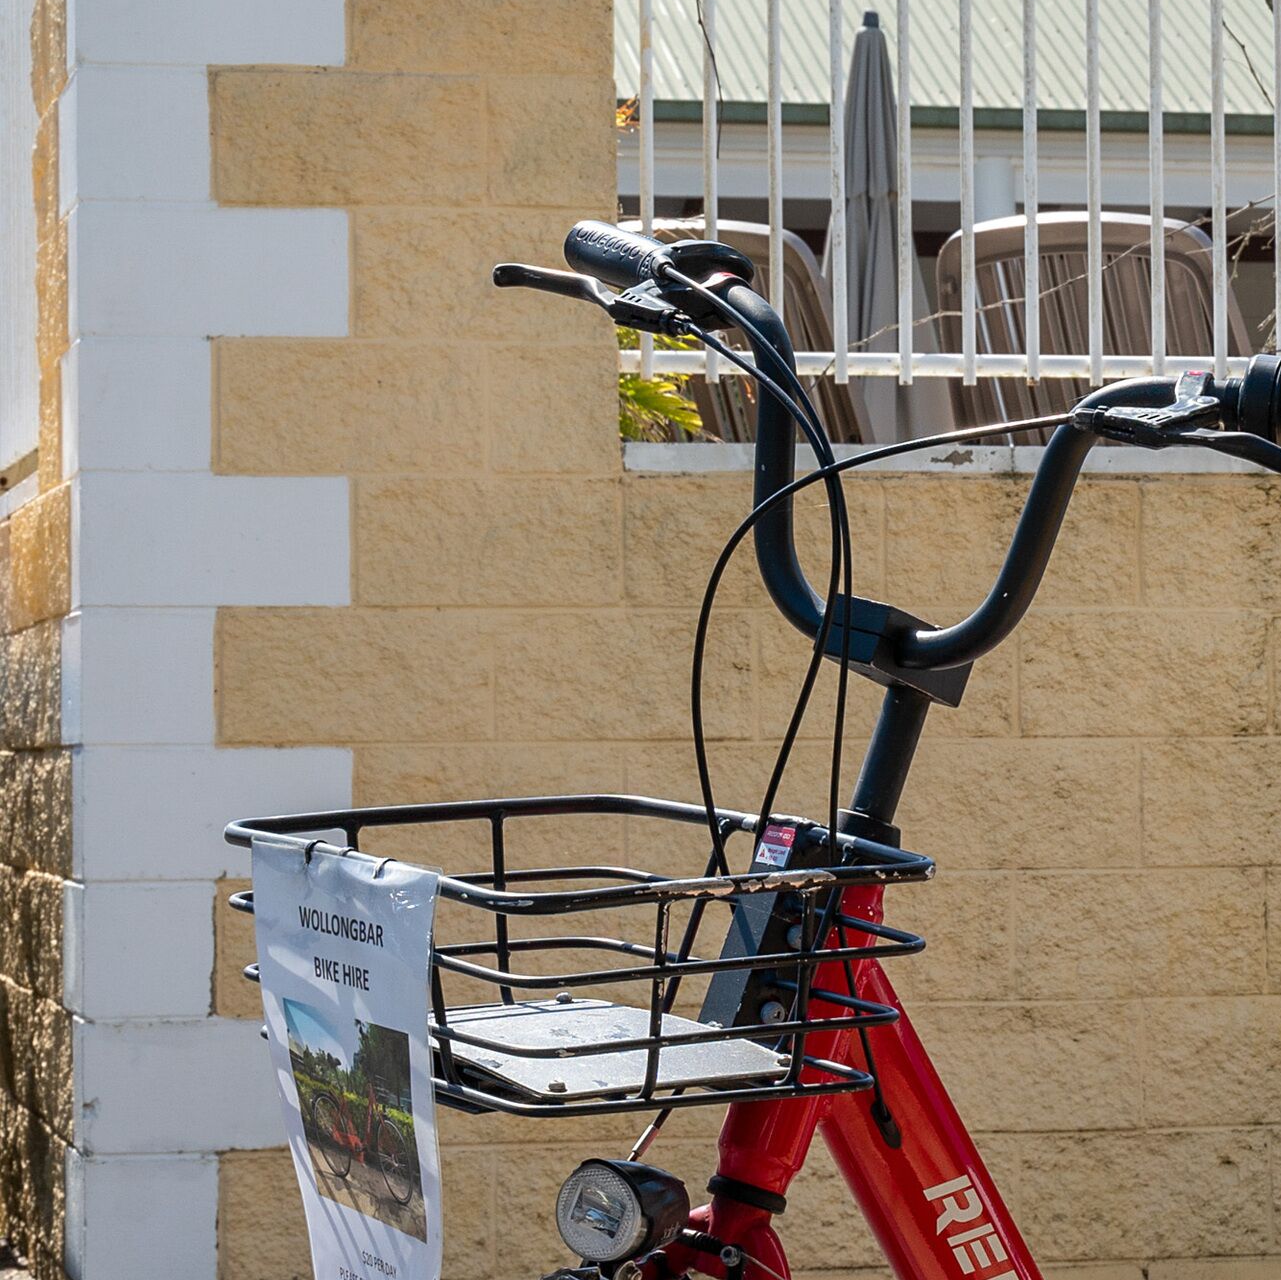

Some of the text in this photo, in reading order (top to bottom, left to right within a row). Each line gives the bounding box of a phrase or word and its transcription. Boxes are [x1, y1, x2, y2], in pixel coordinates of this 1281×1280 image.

[298, 905, 384, 948] WOLLONGBAR
[313, 956, 370, 991] BIKE HIRE
